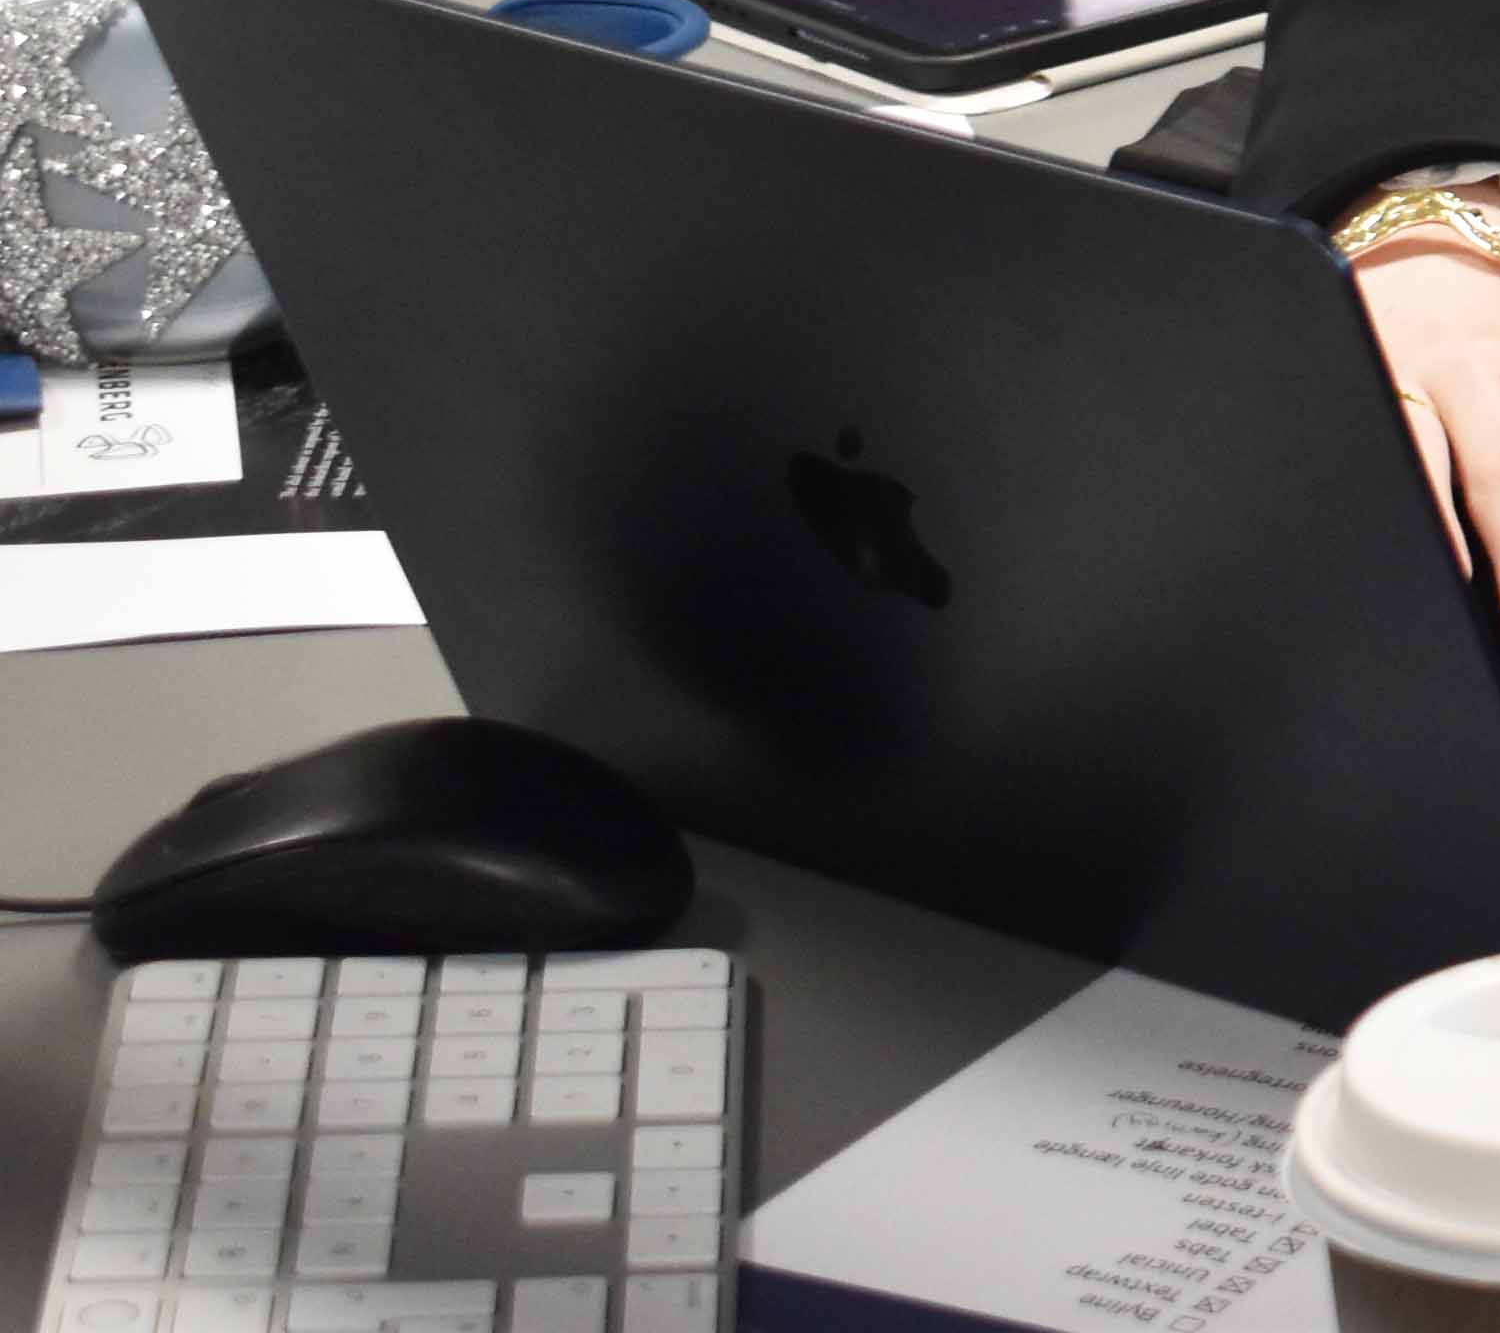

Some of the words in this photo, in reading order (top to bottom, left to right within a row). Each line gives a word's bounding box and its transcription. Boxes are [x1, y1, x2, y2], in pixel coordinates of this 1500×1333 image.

[1032, 1139, 1127, 1169] længde
[1128, 1156, 1186, 1183] linje
[1188, 1170, 1256, 1193] gode
[1184, 1218, 1258, 1245] Tabel
[1172, 1237, 1232, 1265] Tabs
[1065, 1263, 1183, 1304] Textwrap
[1077, 1293, 1162, 1323] Byline
